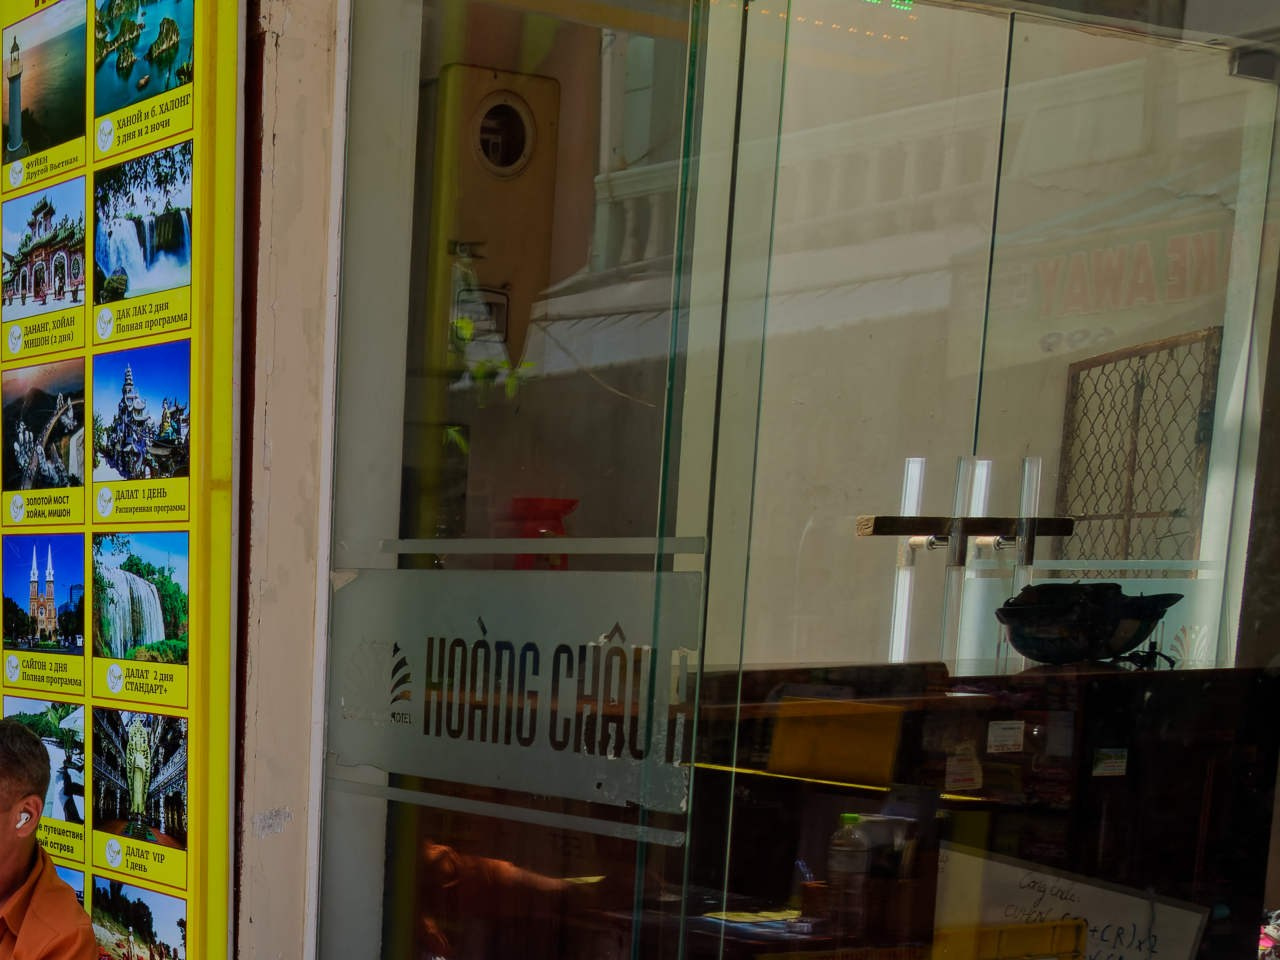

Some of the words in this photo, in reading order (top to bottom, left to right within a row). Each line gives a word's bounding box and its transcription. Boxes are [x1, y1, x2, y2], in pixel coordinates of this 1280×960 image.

[116, 110, 143, 131] ХАНОЙ
[159, 94, 191, 116] ХАЛОНГ
[121, 131, 136, 144] дня
[144, 125, 149, 135] 2
[150, 118, 170, 133] ночи
[26, 155, 48, 169] ФУЙЕН
[26, 164, 49, 181] Другой
[50, 156, 79, 173] Вьетнам
[116, 308, 131, 321] ДАК
[132, 305, 147, 318] ЛАК
[149, 304, 154, 314] 2
[154, 302, 169, 314] дня
[23, 323, 50, 338] ДАНАНГ,
[52, 316, 75, 332] ХОЙАН
[116, 319, 143, 334] Полная
[144, 312, 188, 330] программа
[23, 337, 50, 350] МИШОН
[58, 332, 74, 345] дня)
[26, 495, 52, 506] ЗОЛОТОЙ
[53, 495, 70, 505] МОСТ
[115, 490, 139, 501] ДАЛАТ
[147, 487, 168, 499] ДЕНЬ
[26, 508, 47, 519] ХОЙАН,
[48, 508, 71, 518] МИШОН
[115, 505, 153, 515] Расширенная
[153, 504, 186, 514] программа
[21, 659, 47, 671] САЙГОН
[49, 662, 53, 672] 2
[53, 662, 68, 673] ДНЯ
[21, 671, 45, 683] Полная
[45, 675, 82, 688] программа
[125, 668, 150, 680] ДАЛАТ
[153, 670, 158, 680] 2
[158, 672, 174, 683] дня
[125, 682, 168, 695] СТАНДАРТ+
[43, 824, 84, 841] путешествие
[49, 841, 74, 854] острова
[126, 845, 150, 861] ДАЛАТ
[152, 851, 166, 864] VIP
[129, 861, 148, 873] день
